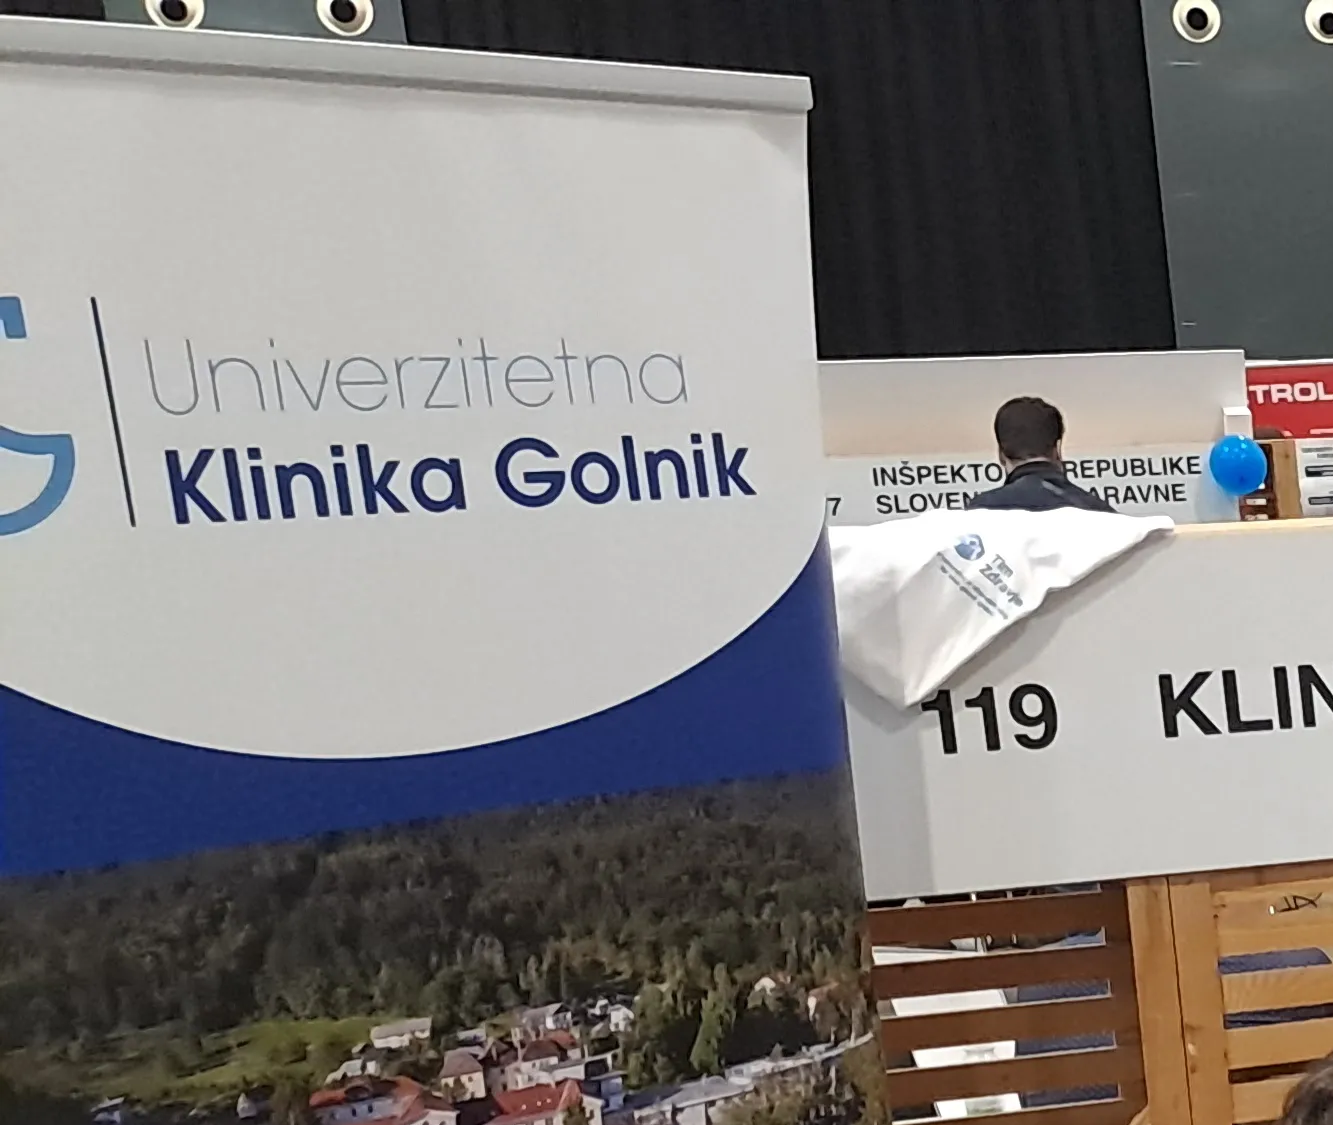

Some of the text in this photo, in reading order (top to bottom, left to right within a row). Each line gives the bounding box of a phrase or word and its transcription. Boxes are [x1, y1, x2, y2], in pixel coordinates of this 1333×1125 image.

[144, 337, 690, 416] Univerzitetna
[165, 432, 758, 526] Klinika Golnik
[1062, 456, 1203, 480] REPUBLIKE
[920, 684, 1059, 754] 119
